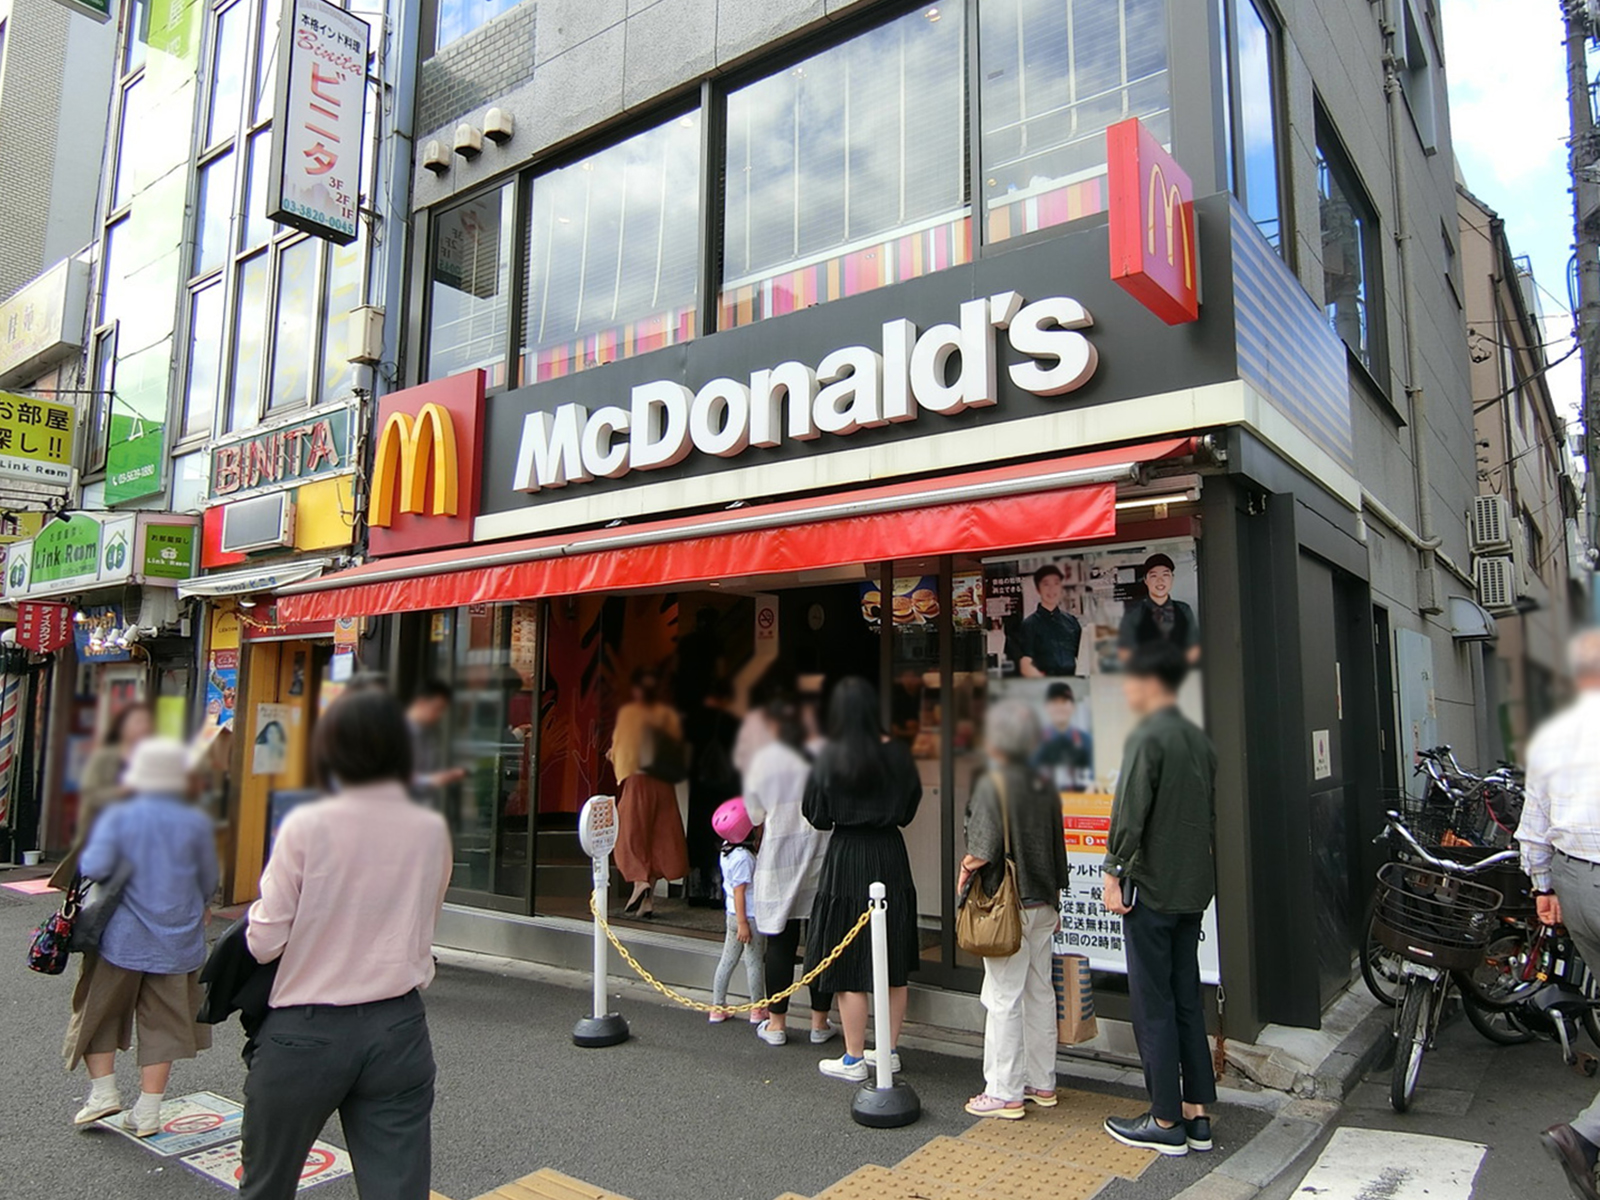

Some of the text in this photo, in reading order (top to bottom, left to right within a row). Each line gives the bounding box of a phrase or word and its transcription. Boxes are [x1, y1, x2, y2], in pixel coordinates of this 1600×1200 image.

[301, 13, 361, 54] 本格インド料理
[297, 29, 362, 76] Binita
[329, 176, 344, 190] 3F
[335, 192, 351, 206] 2F
[283, 198, 354, 235] 03-3820-0045
[341, 207, 354, 219] 1F
[513, 291, 1098, 494] McDonald's
[0, 460, 30, 472] Link
[214, 418, 340, 496] BINITA
[35, 546, 61, 570] Link
[65, 542, 97, 562] Room
[147, 557, 165, 565] Link
[1065, 863, 1104, 878] ナルド
